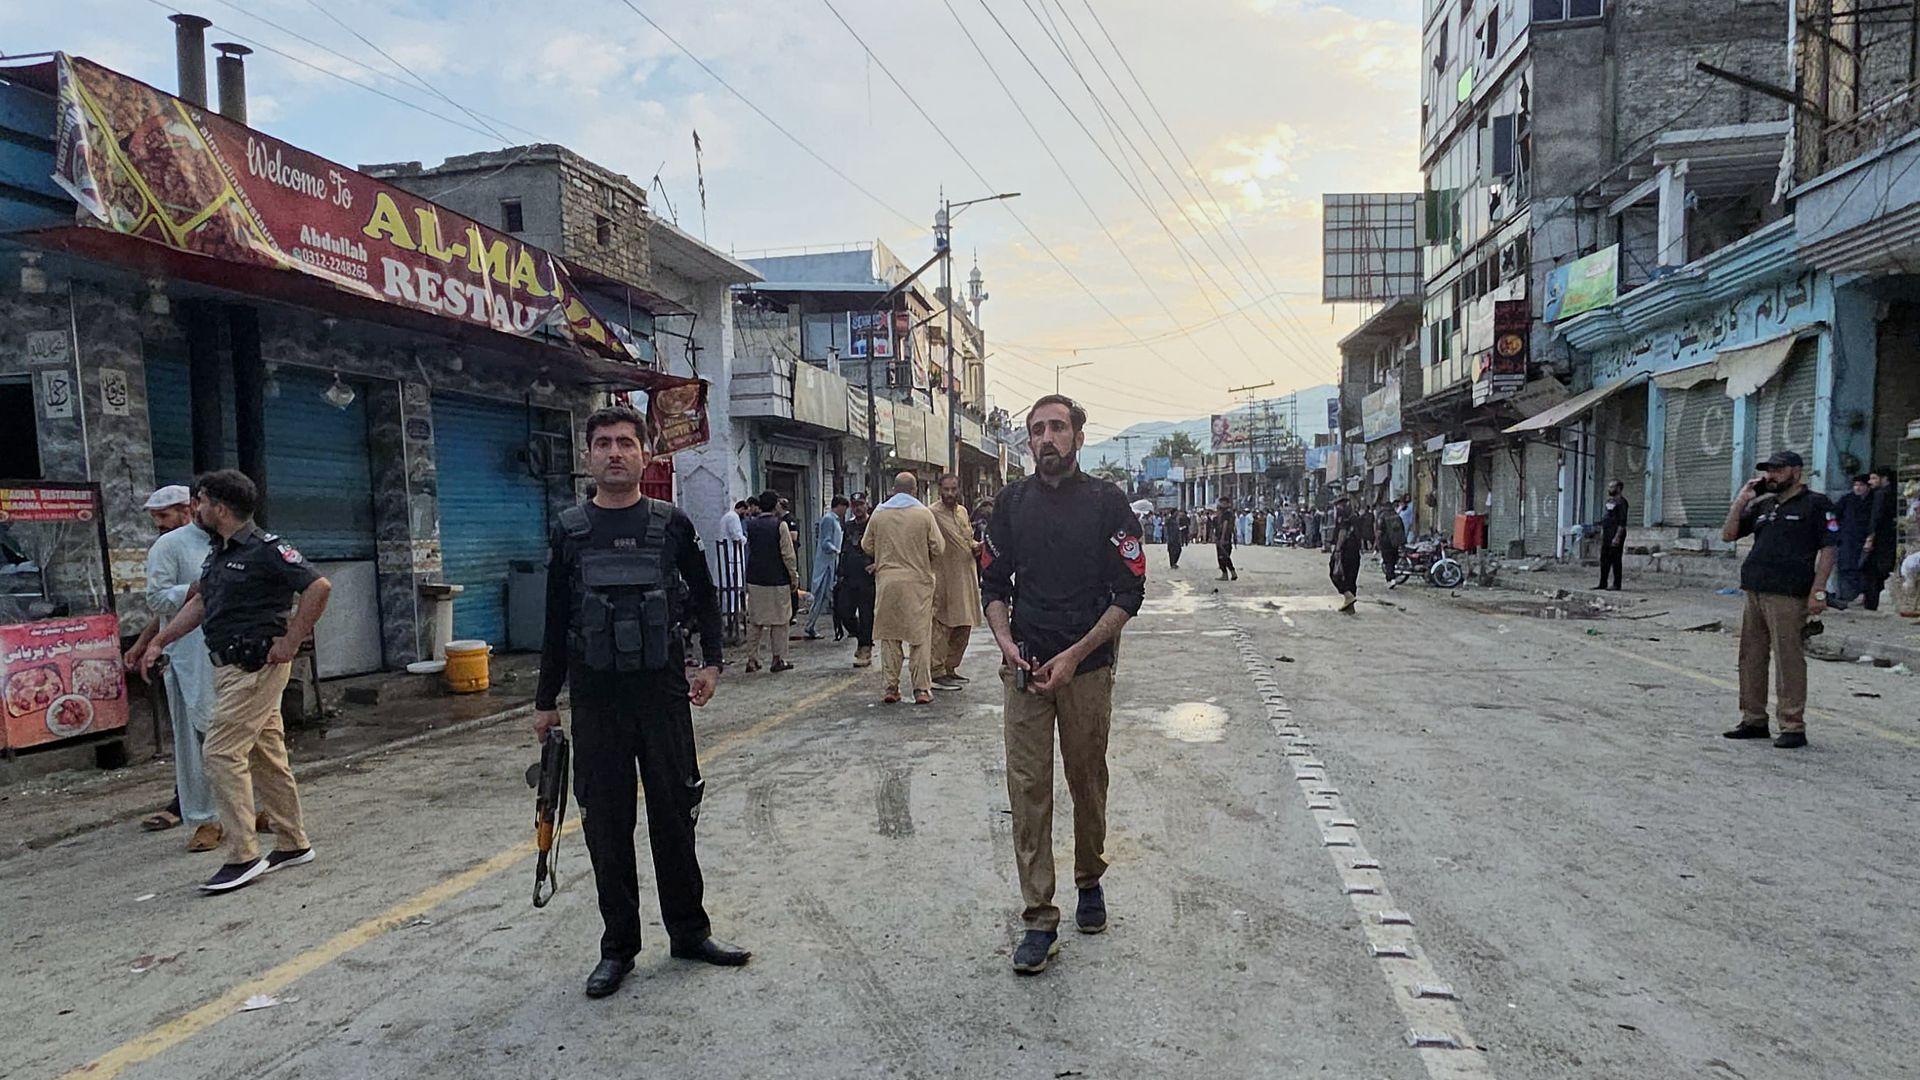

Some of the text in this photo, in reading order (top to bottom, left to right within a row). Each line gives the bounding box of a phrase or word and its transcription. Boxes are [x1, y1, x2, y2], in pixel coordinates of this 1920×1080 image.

[246, 136, 354, 210] Welcome To
[300, 224, 368, 263] Abdullah
[302, 249, 368, 281] 0312-2248263
[381, 256, 549, 332] RESTAU
